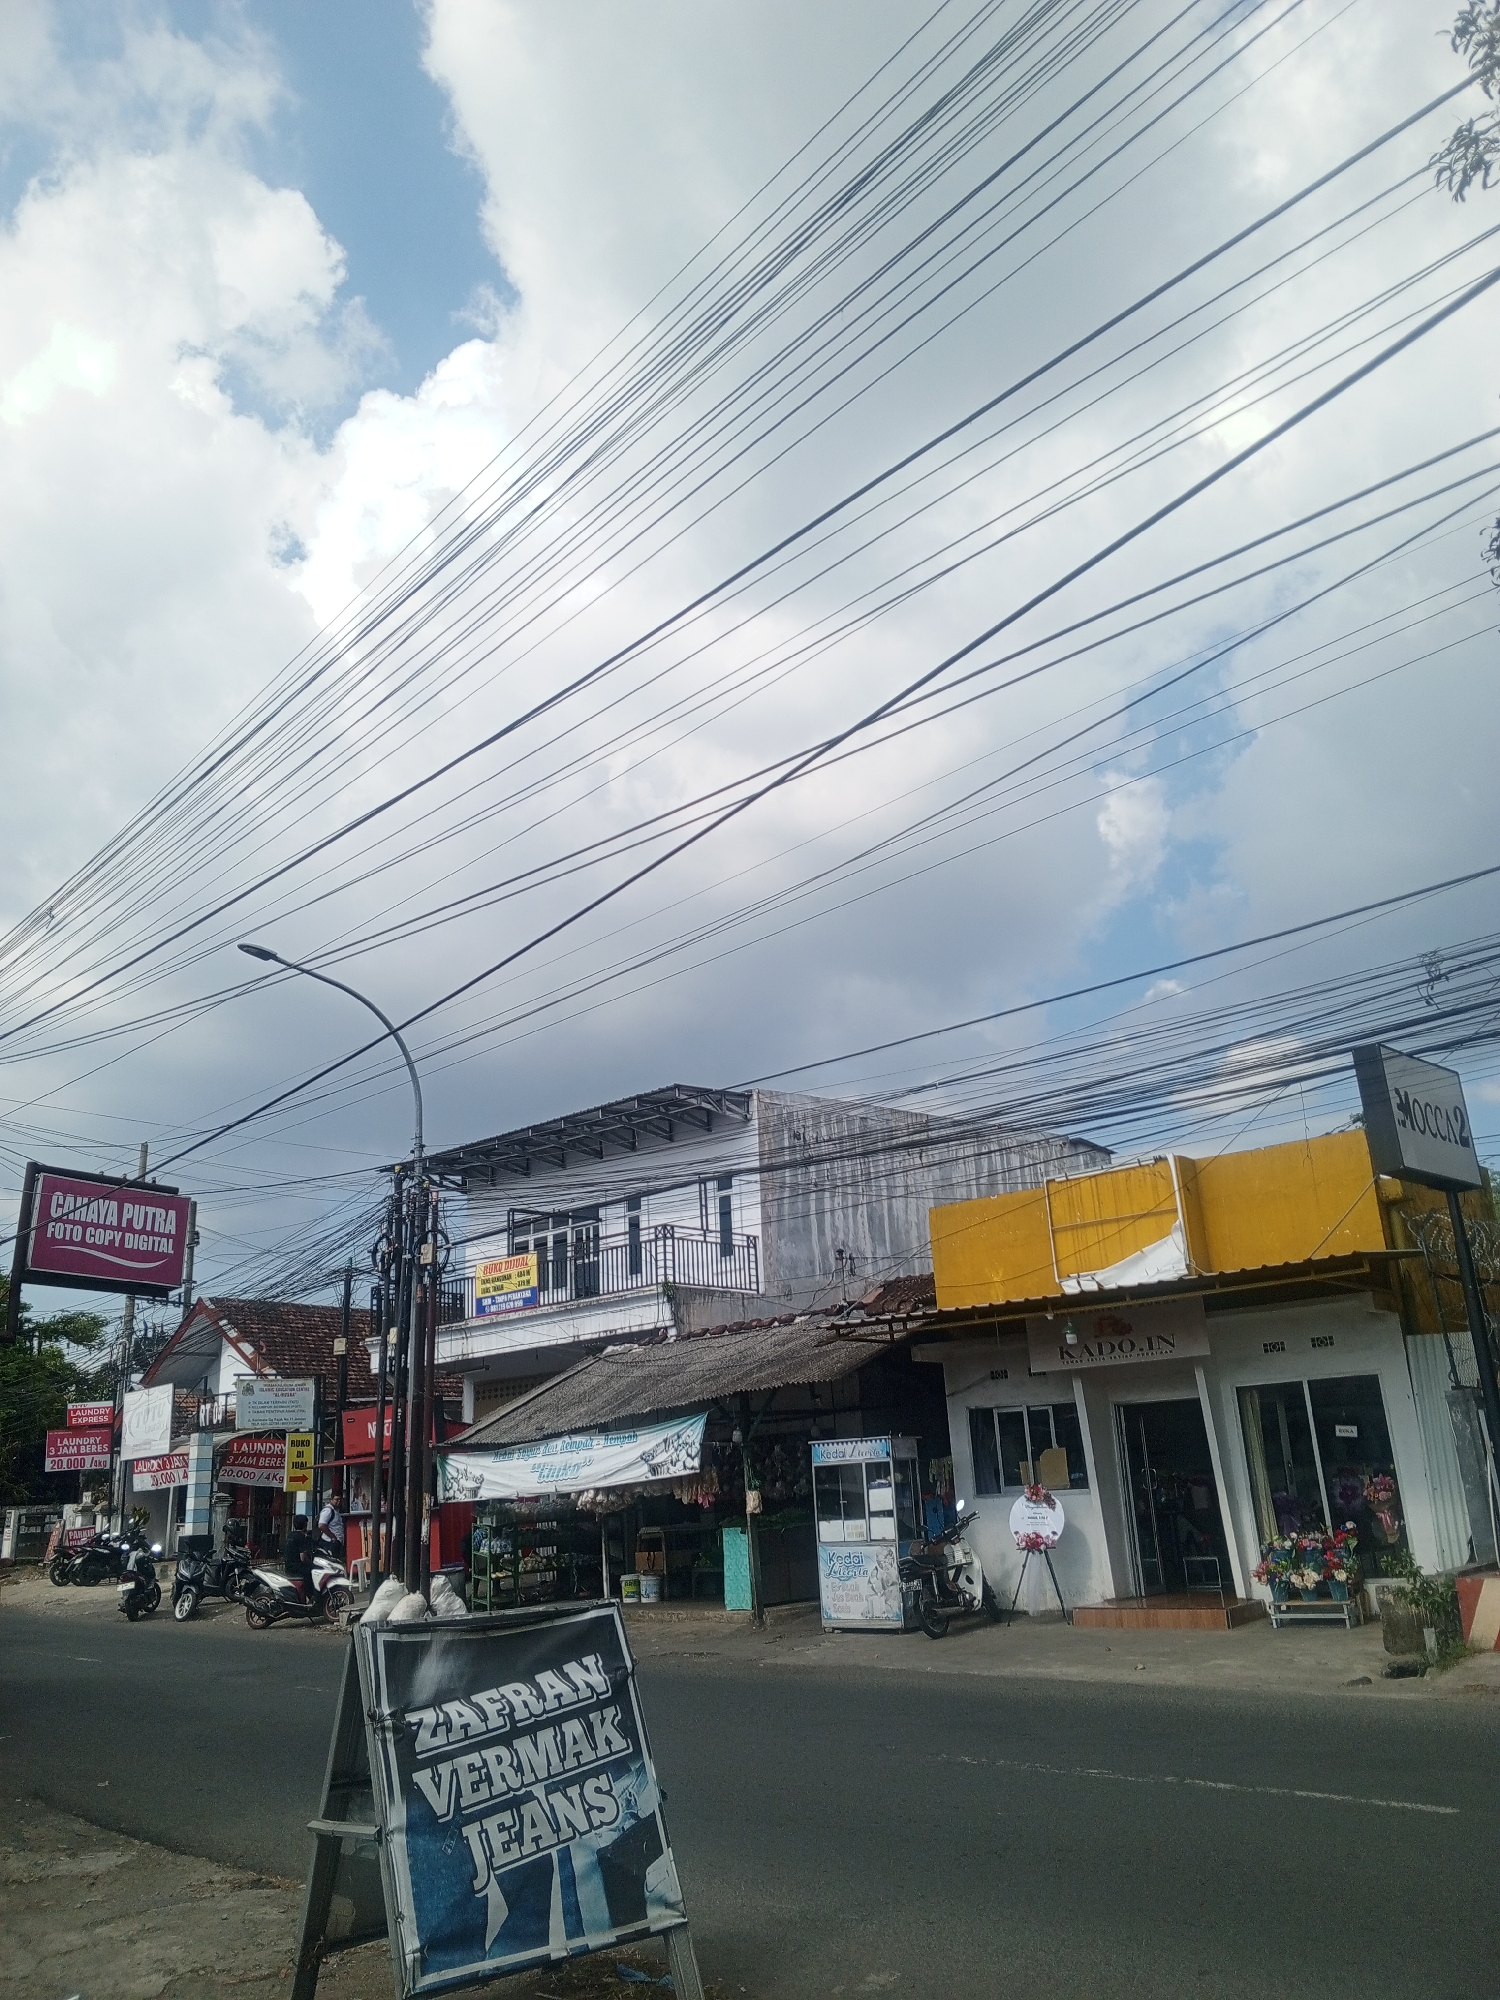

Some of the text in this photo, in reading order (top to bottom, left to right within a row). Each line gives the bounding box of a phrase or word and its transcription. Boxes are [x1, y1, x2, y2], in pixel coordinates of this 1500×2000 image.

[50, 1191, 176, 1234] CAHAYA PUTRA
[46, 1222, 174, 1254] FOTO COPY DIGITAL
[484, 1256, 528, 1275] RUKO DIJUAL
[1058, 1334, 1176, 1360] KADO.IN
[70, 1408, 110, 1416] LAUNDRY
[200, 1403, 212, 1427] RT
[72, 1416, 108, 1424] EXPRESS
[57, 1436, 102, 1446] LAUNDRY
[233, 1442, 286, 1454] LAUNDRY
[560, 1437, 594, 1454] Rempah
[603, 1431, 638, 1448] Rempah
[58, 1446, 77, 1454] JAM
[80, 1444, 108, 1453] BERES
[820, 1448, 846, 1459] Kedai
[50, 1457, 86, 1470] 20.000
[226, 1456, 285, 1466] 3 JAM BERES
[220, 1469, 256, 1480] 20.000
[828, 1551, 864, 1565] Kedai
[405, 1652, 611, 1759] ZAFRAN
[412, 1705, 634, 1822] VERMAK
[462, 1772, 624, 1898] JEANS
